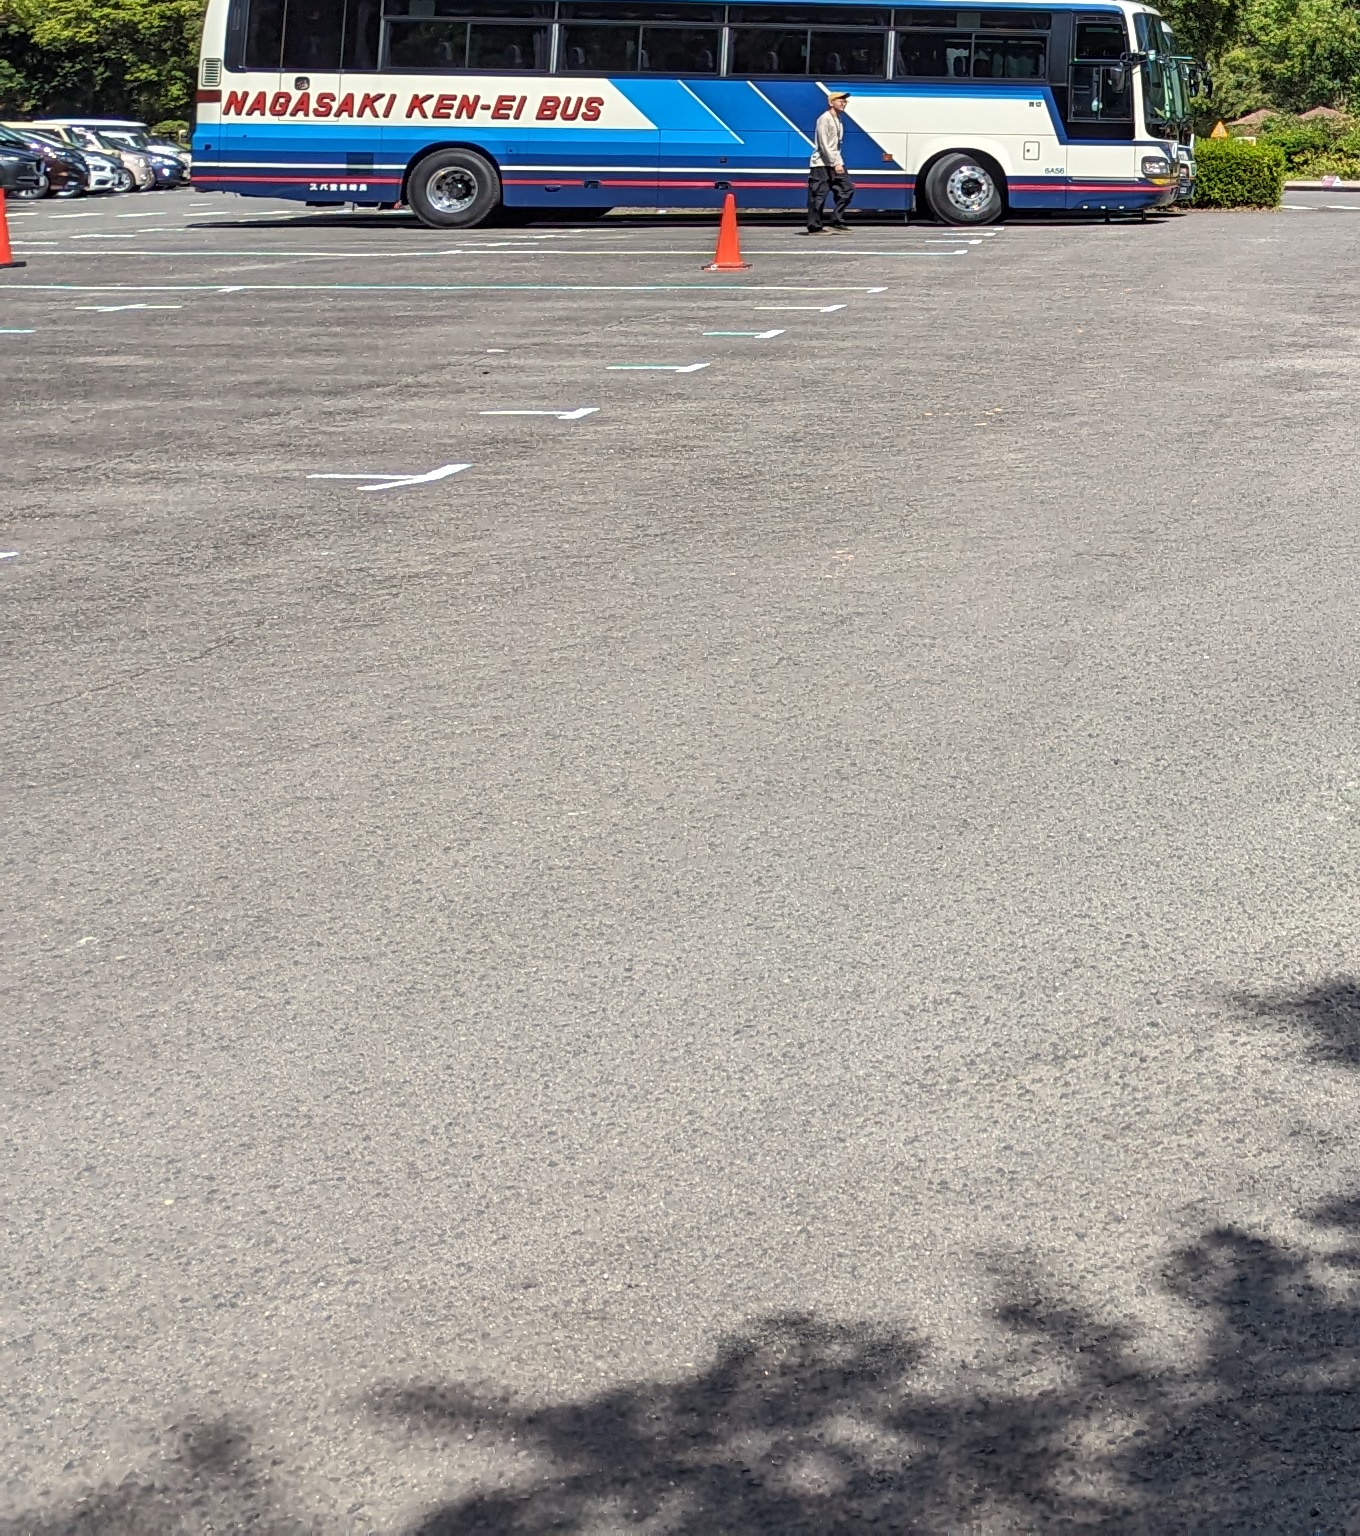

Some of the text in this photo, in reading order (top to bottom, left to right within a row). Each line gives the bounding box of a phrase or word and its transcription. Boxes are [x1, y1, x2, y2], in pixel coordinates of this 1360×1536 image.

[222, 90, 605, 122] NAGASAKI KEN-EI BUS
